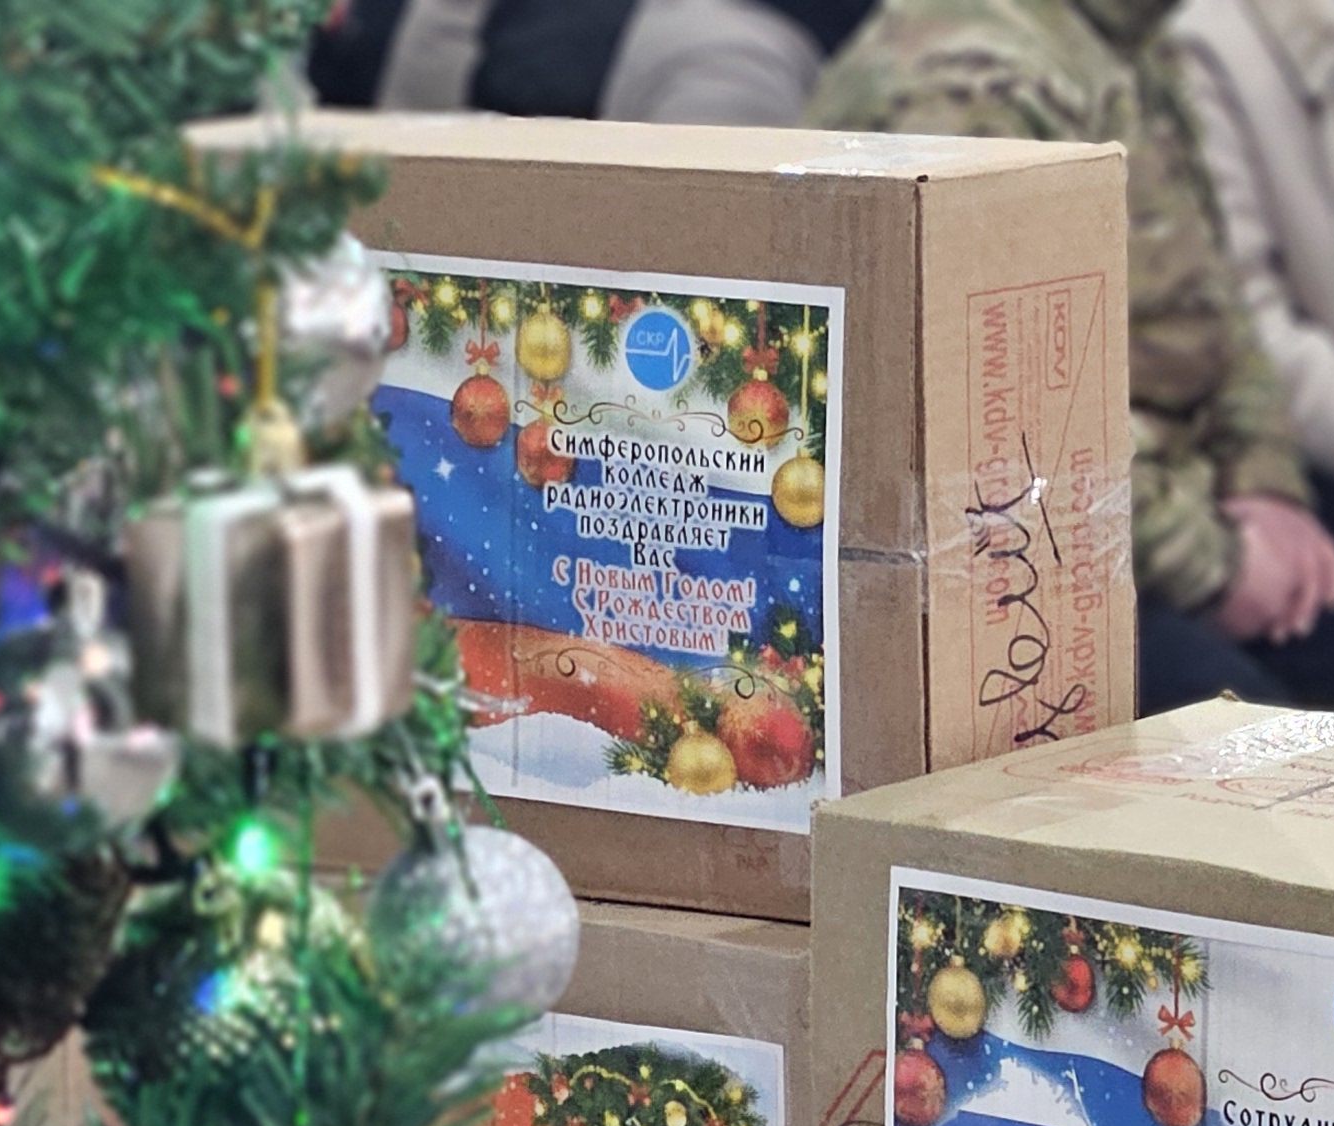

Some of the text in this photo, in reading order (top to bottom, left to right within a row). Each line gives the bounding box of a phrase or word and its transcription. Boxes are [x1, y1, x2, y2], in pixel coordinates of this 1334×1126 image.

[551, 429, 766, 473] Симферопольский
[605, 465, 706, 493] колледж
[547, 486, 765, 526] радиоэлектроники
[580, 515, 728, 549] поздравляет
[633, 543, 673, 568] Вас
[556, 557, 756, 604] С Новым Годом!
[575, 587, 749, 630] С Рождеством
[584, 613, 729, 650] Христовым!
